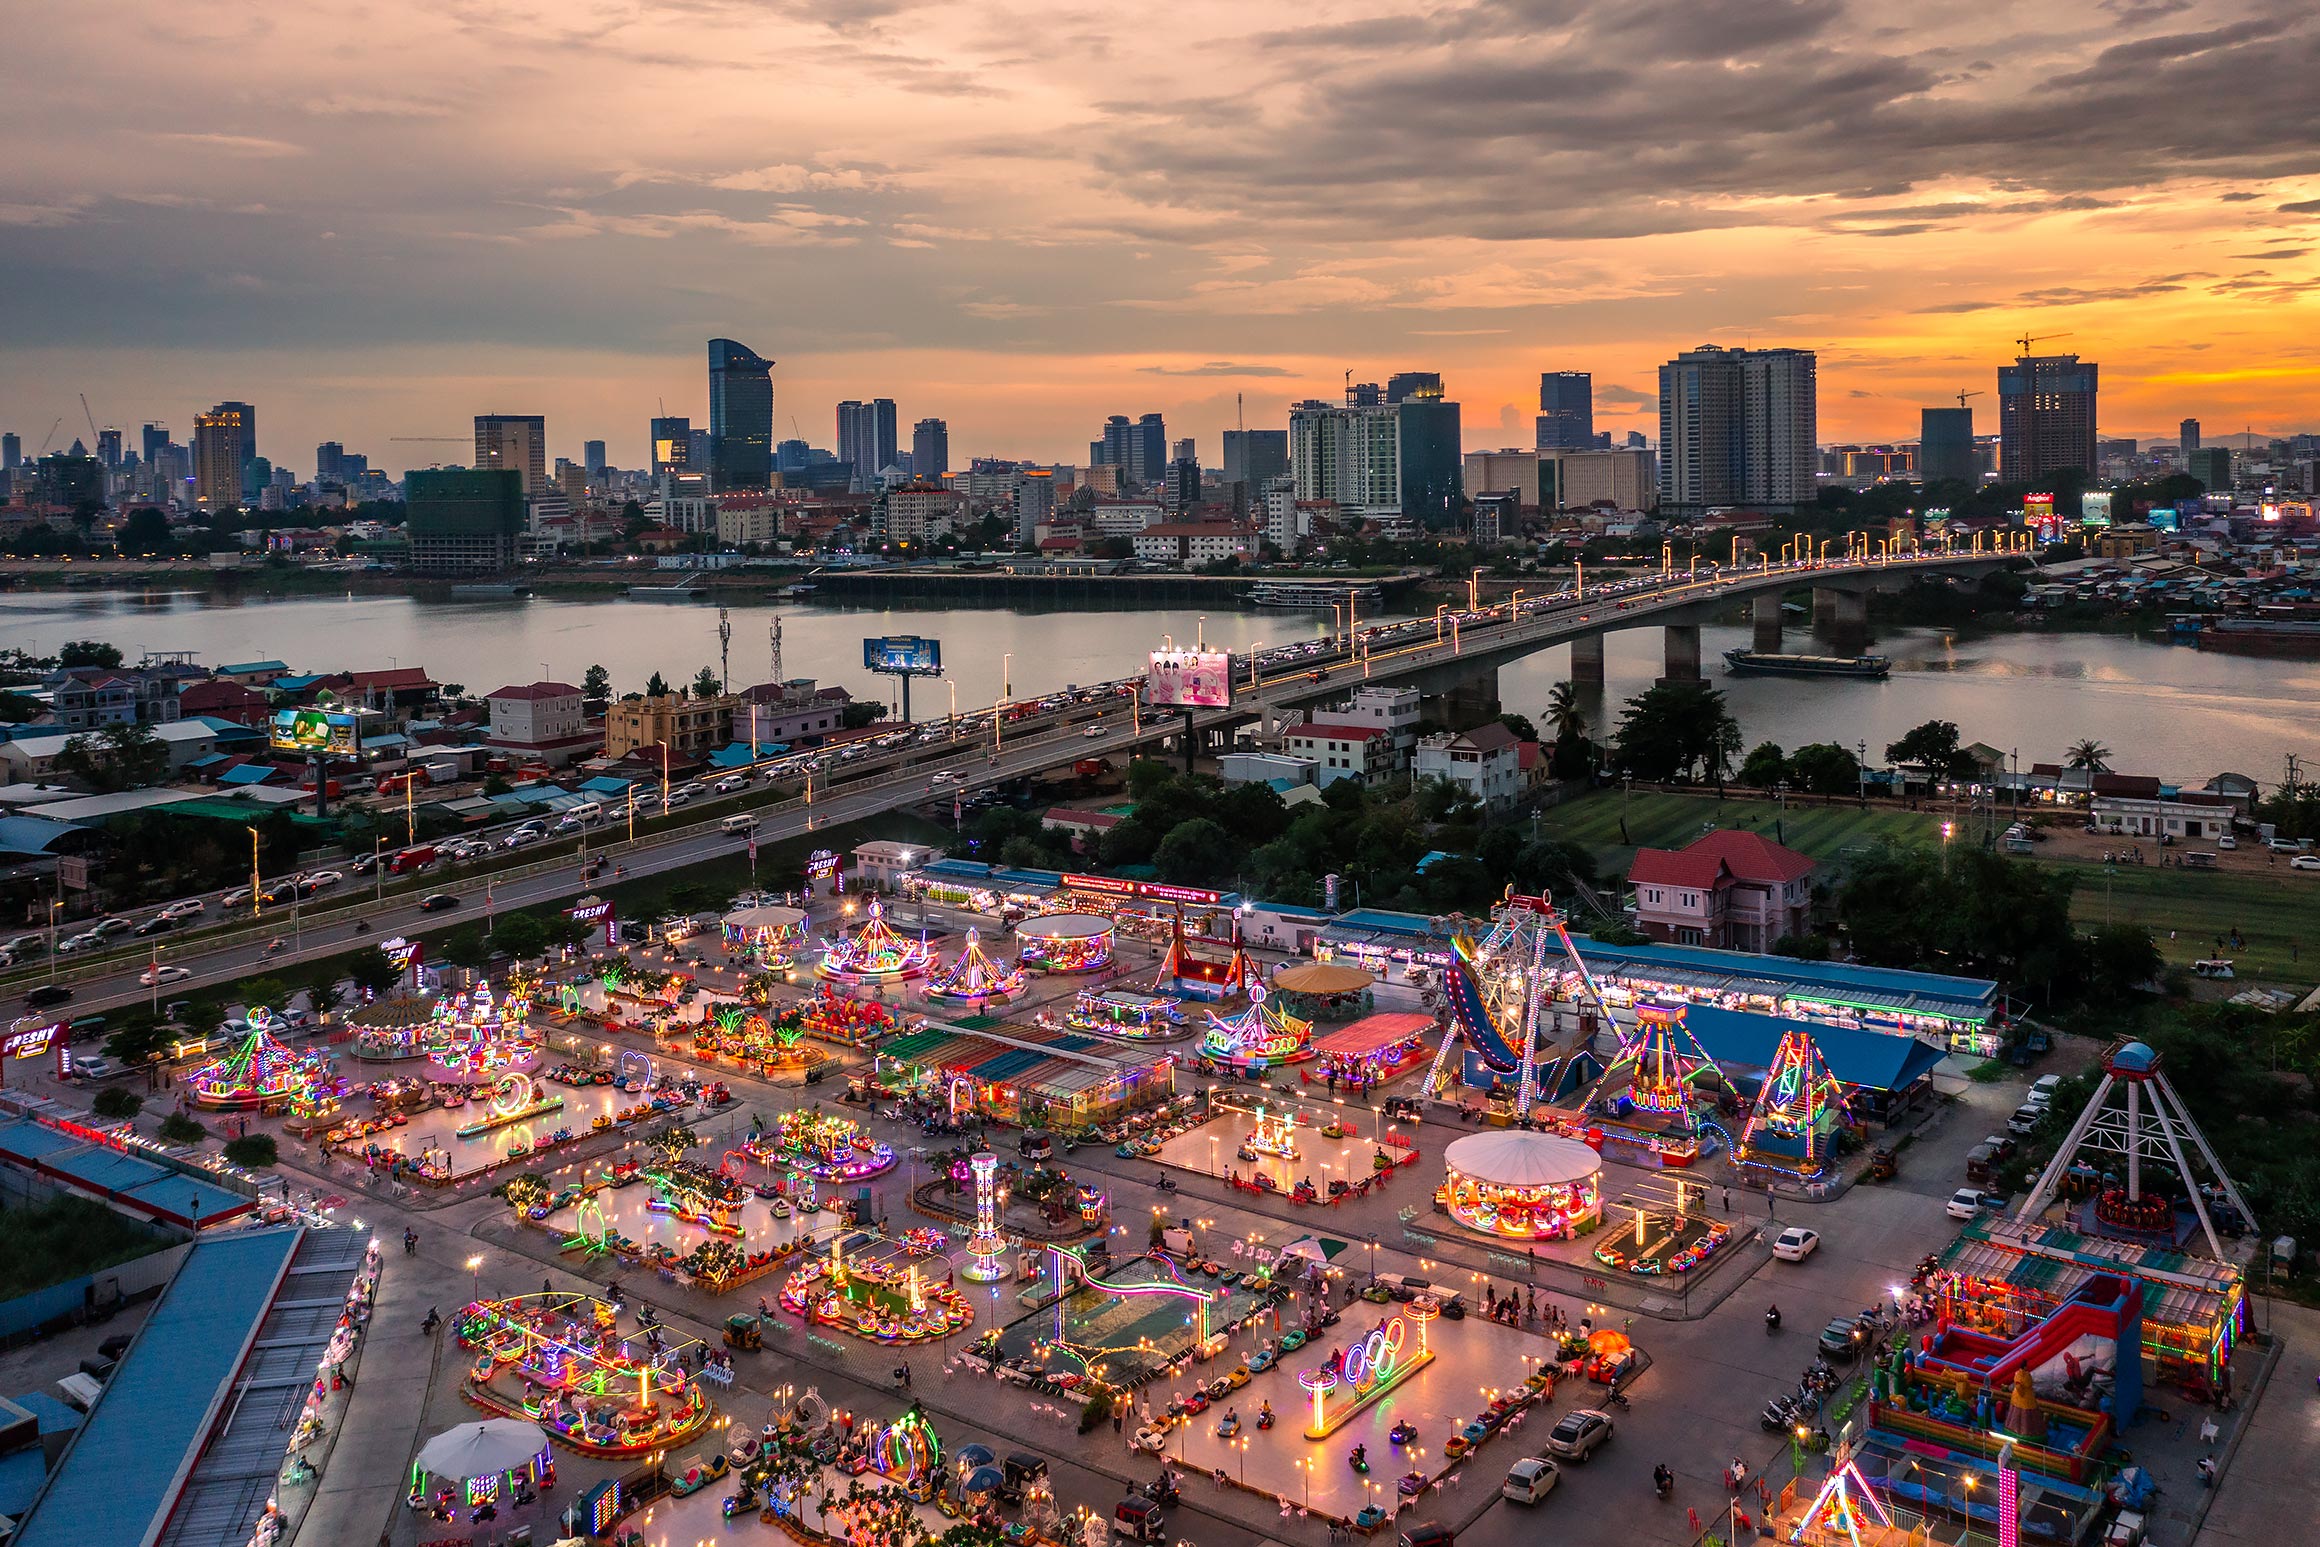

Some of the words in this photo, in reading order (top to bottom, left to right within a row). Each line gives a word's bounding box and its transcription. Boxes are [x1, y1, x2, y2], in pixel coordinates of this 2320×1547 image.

[2027, 495, 2050, 503] Angkor
[808, 856, 839, 874] FRESHY
[572, 903, 610, 921] FRESHY
[3, 1024, 59, 1052] FRESHY
